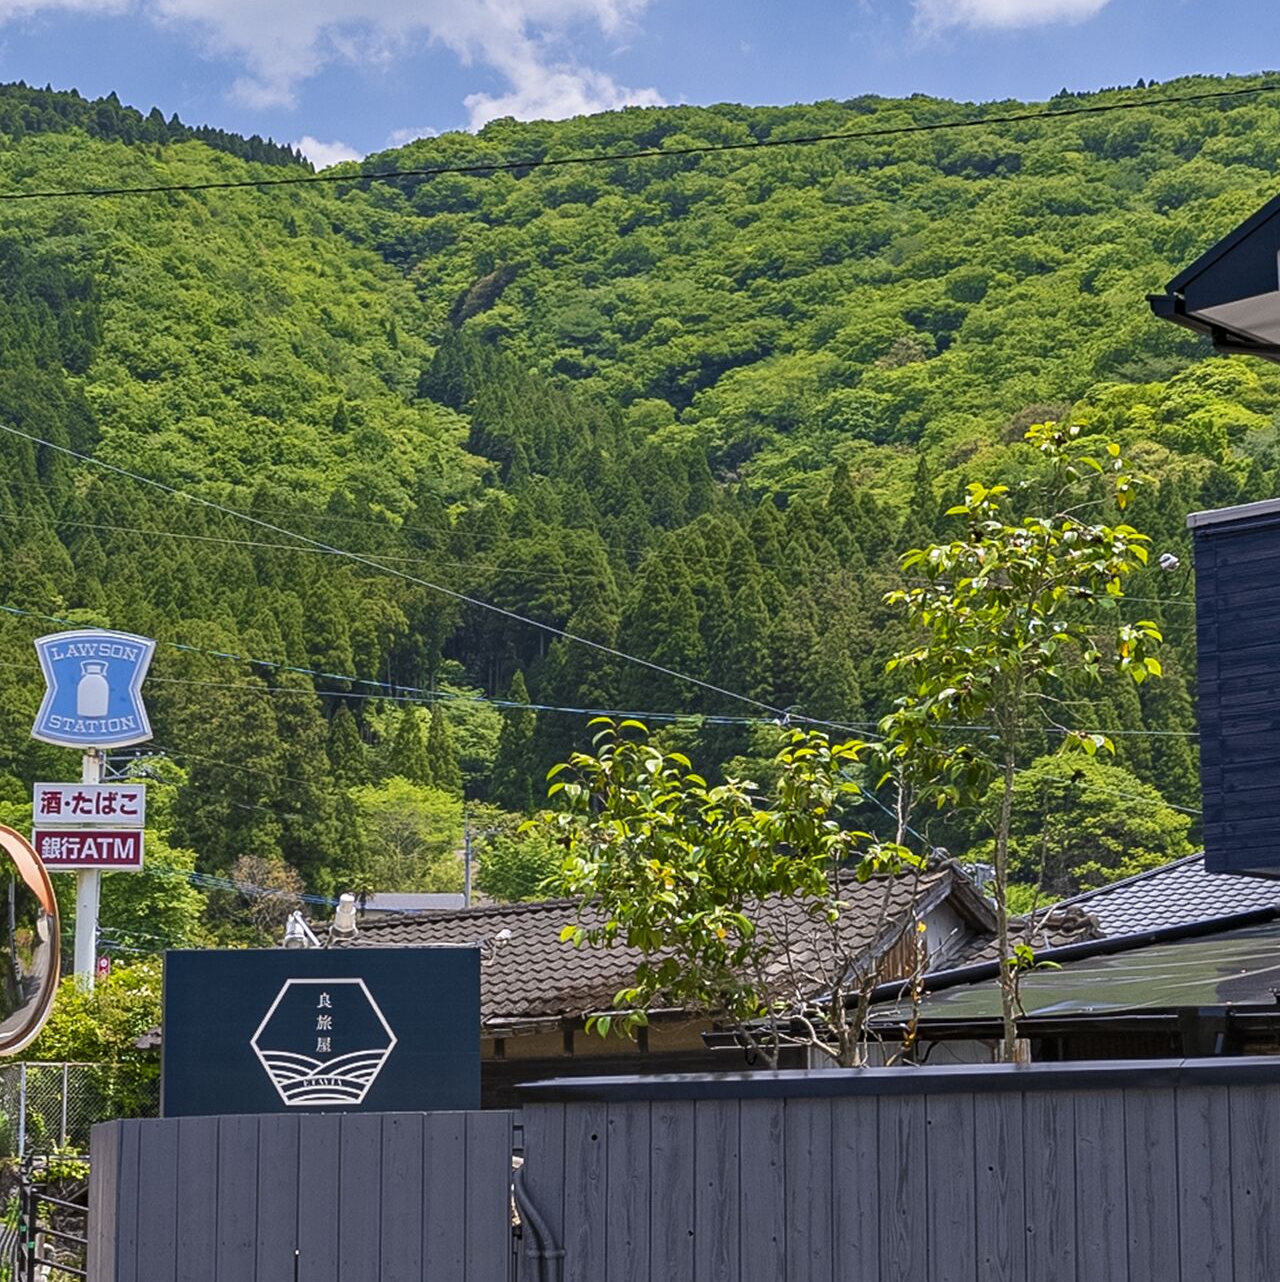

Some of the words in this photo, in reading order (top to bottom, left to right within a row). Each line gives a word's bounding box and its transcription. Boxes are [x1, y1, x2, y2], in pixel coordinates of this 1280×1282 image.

[51, 643, 138, 662] LAWSON
[48, 715, 136, 734] STATION
[40, 790, 138, 815] 酒・たばこ
[41, 837, 135, 859] 銀行ATM
[316, 992, 333, 1053] 良旅屋
